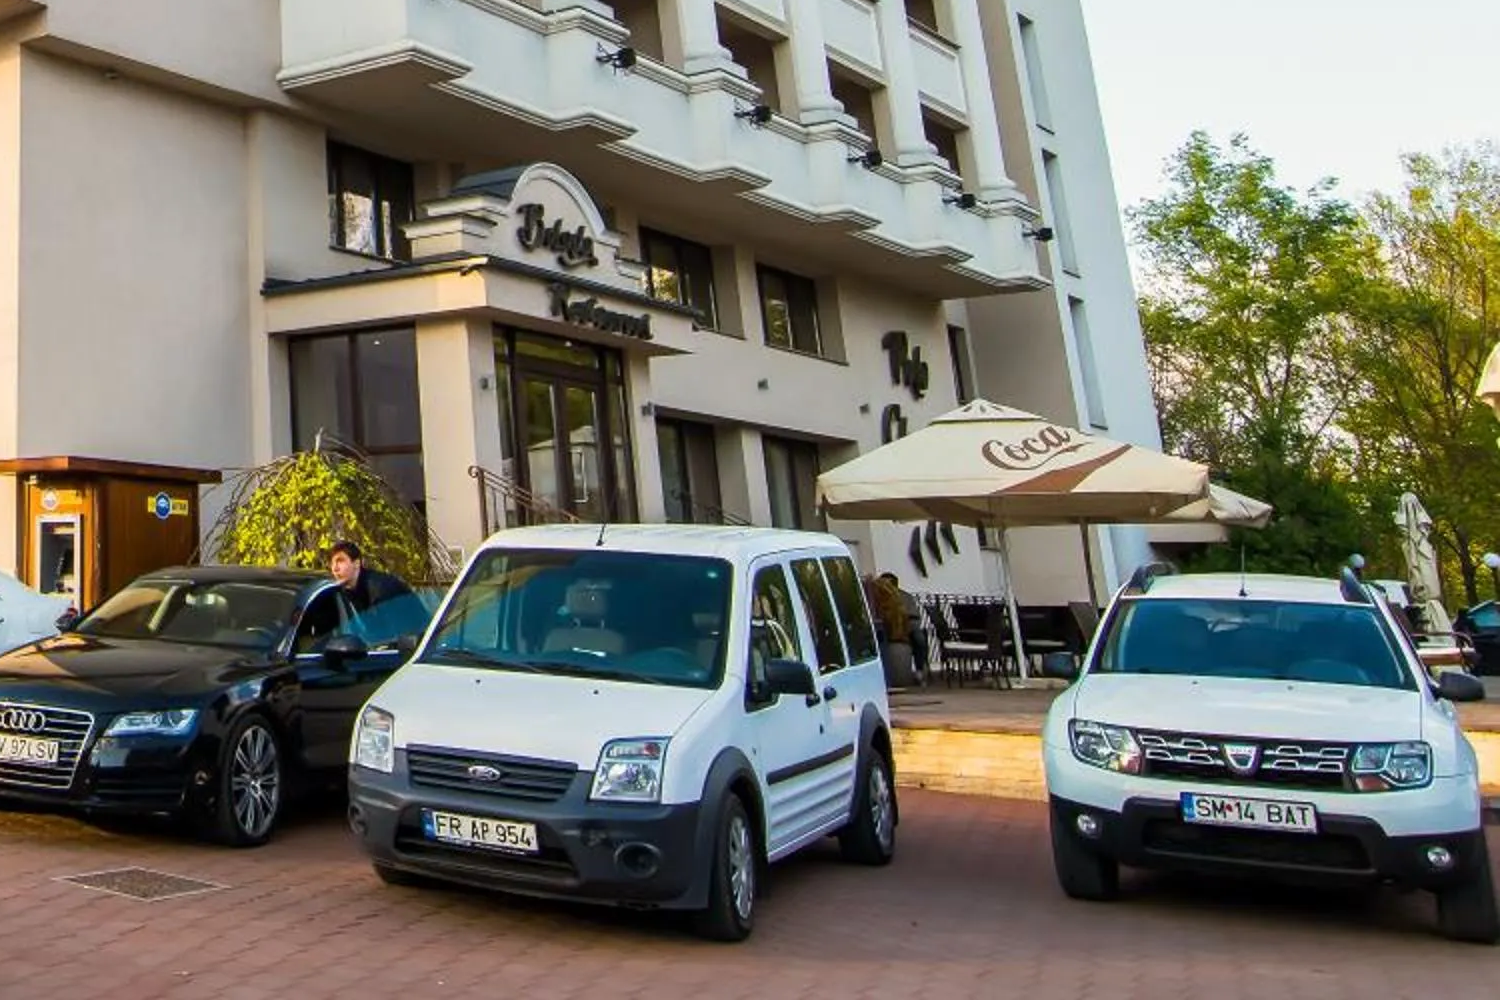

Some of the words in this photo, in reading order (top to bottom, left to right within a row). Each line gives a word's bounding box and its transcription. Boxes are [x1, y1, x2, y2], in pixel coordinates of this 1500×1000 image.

[982, 426, 1092, 471] Coca
[435, 814, 462, 837] FR
[471, 820, 489, 841] AP
[495, 823, 531, 846] 954
[1266, 803, 1309, 825] BAT
